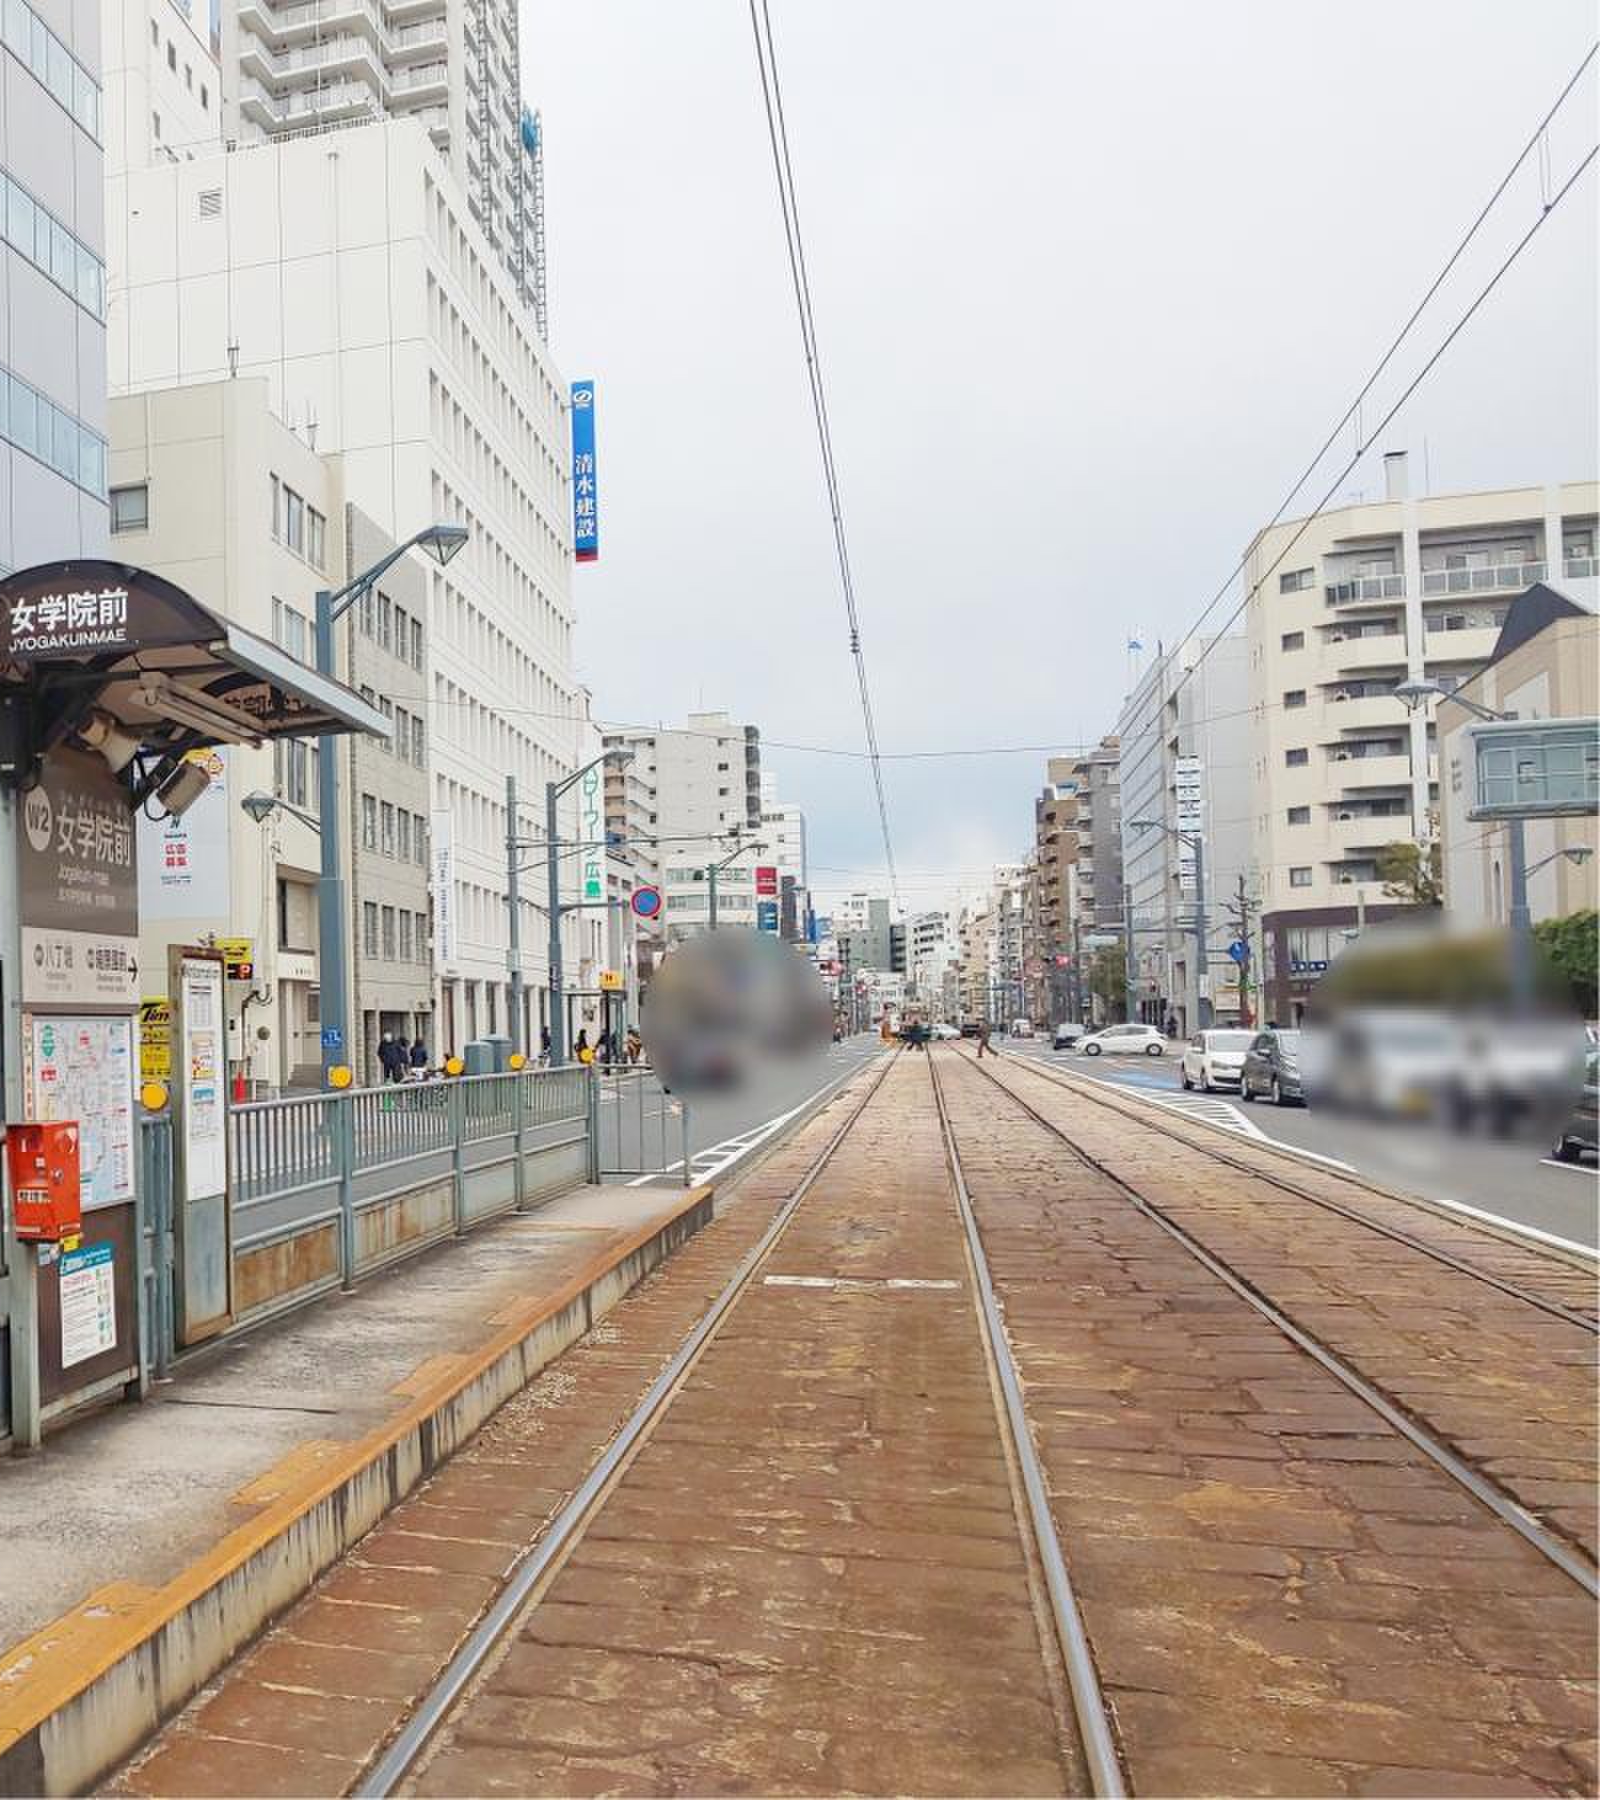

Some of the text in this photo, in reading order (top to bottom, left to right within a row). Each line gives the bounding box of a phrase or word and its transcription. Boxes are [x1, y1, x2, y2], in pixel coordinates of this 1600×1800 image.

[575, 453, 594, 538] 清水建設
[9, 587, 128, 635] 女学院前
[9, 628, 126, 653] JYOGAKUINMAE
[27, 803, 50, 832] W2
[55, 804, 130, 867] 女学院前
[141, 1003, 169, 1023] Tim
